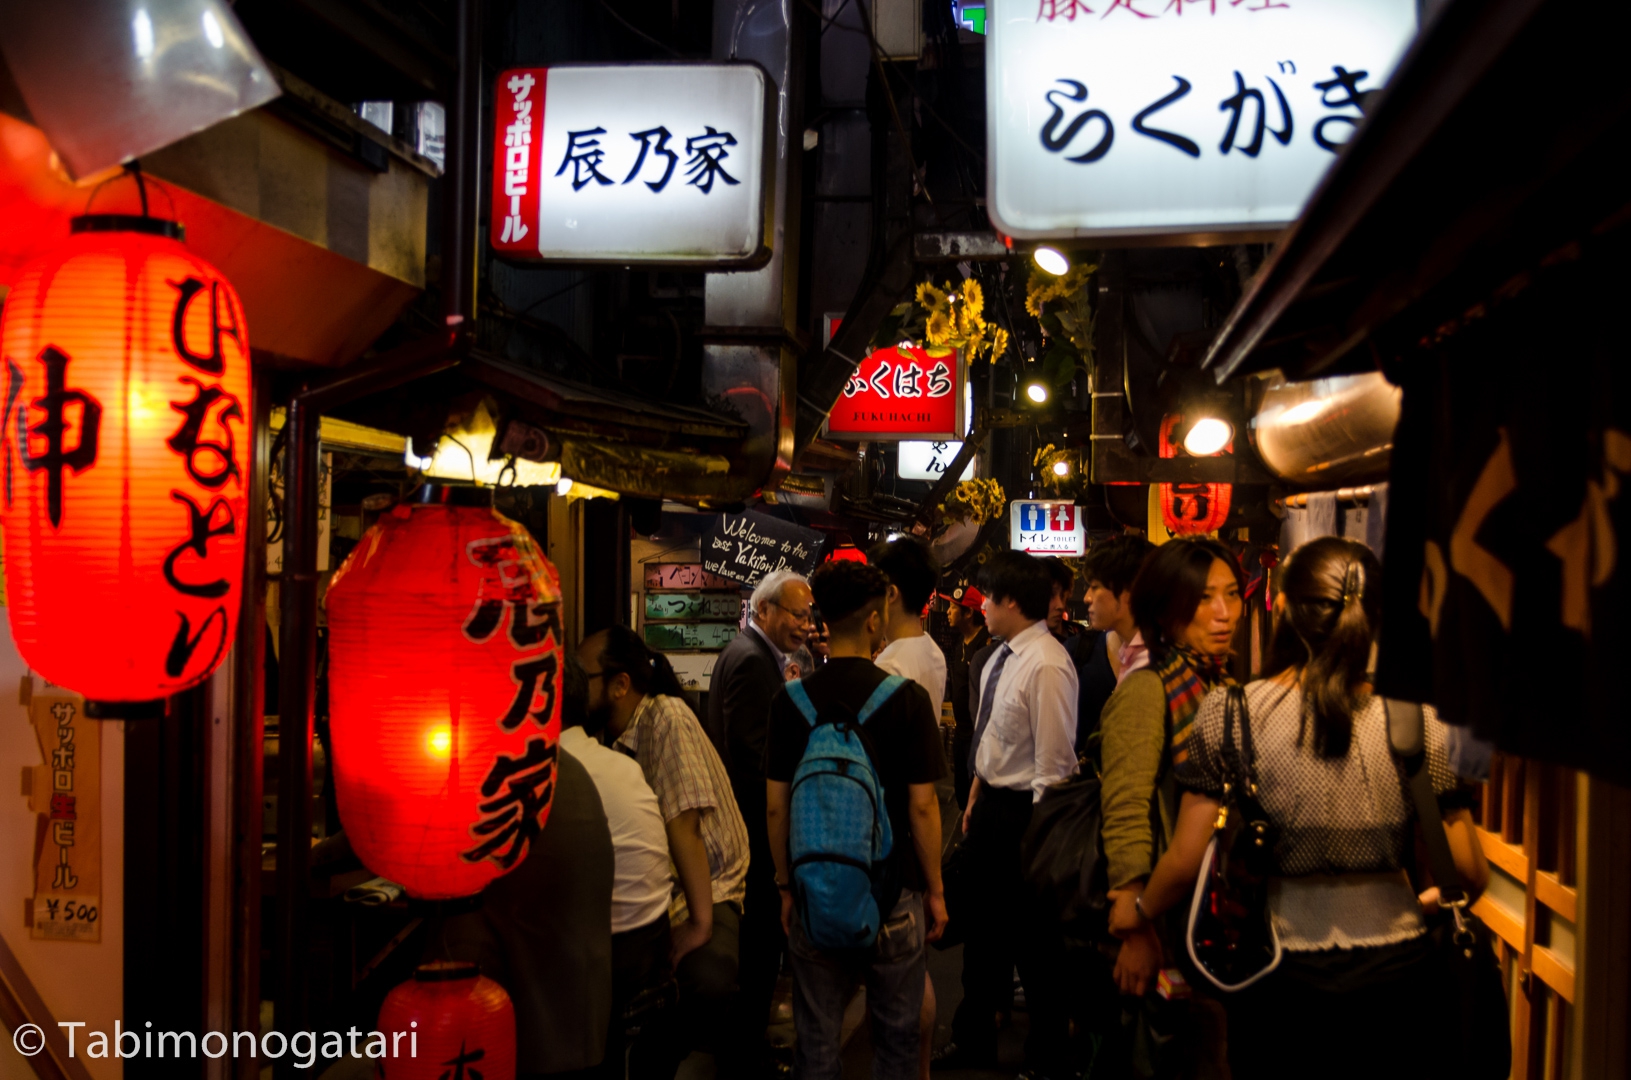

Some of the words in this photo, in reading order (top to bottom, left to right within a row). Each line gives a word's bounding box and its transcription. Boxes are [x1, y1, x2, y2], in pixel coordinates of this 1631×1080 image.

[500, 73, 535, 243] サッポロビール
[554, 125, 742, 195] 辰乃家
[853, 412, 931, 422] FUKUHACHI
[722, 512, 776, 547] Welcome
[781, 540, 792, 553] to
[792, 542, 808, 560] the
[1020, 533, 1049, 543] トイレ
[704, 559, 720, 572] we
[718, 560, 736, 578] have
[735, 541, 776, 573] Yakitori
[667, 597, 711, 614] つくね
[712, 599, 737, 616] 300
[51, 703, 78, 889] サッポロ生ビール
[46, 899, 98, 922] ¥500
